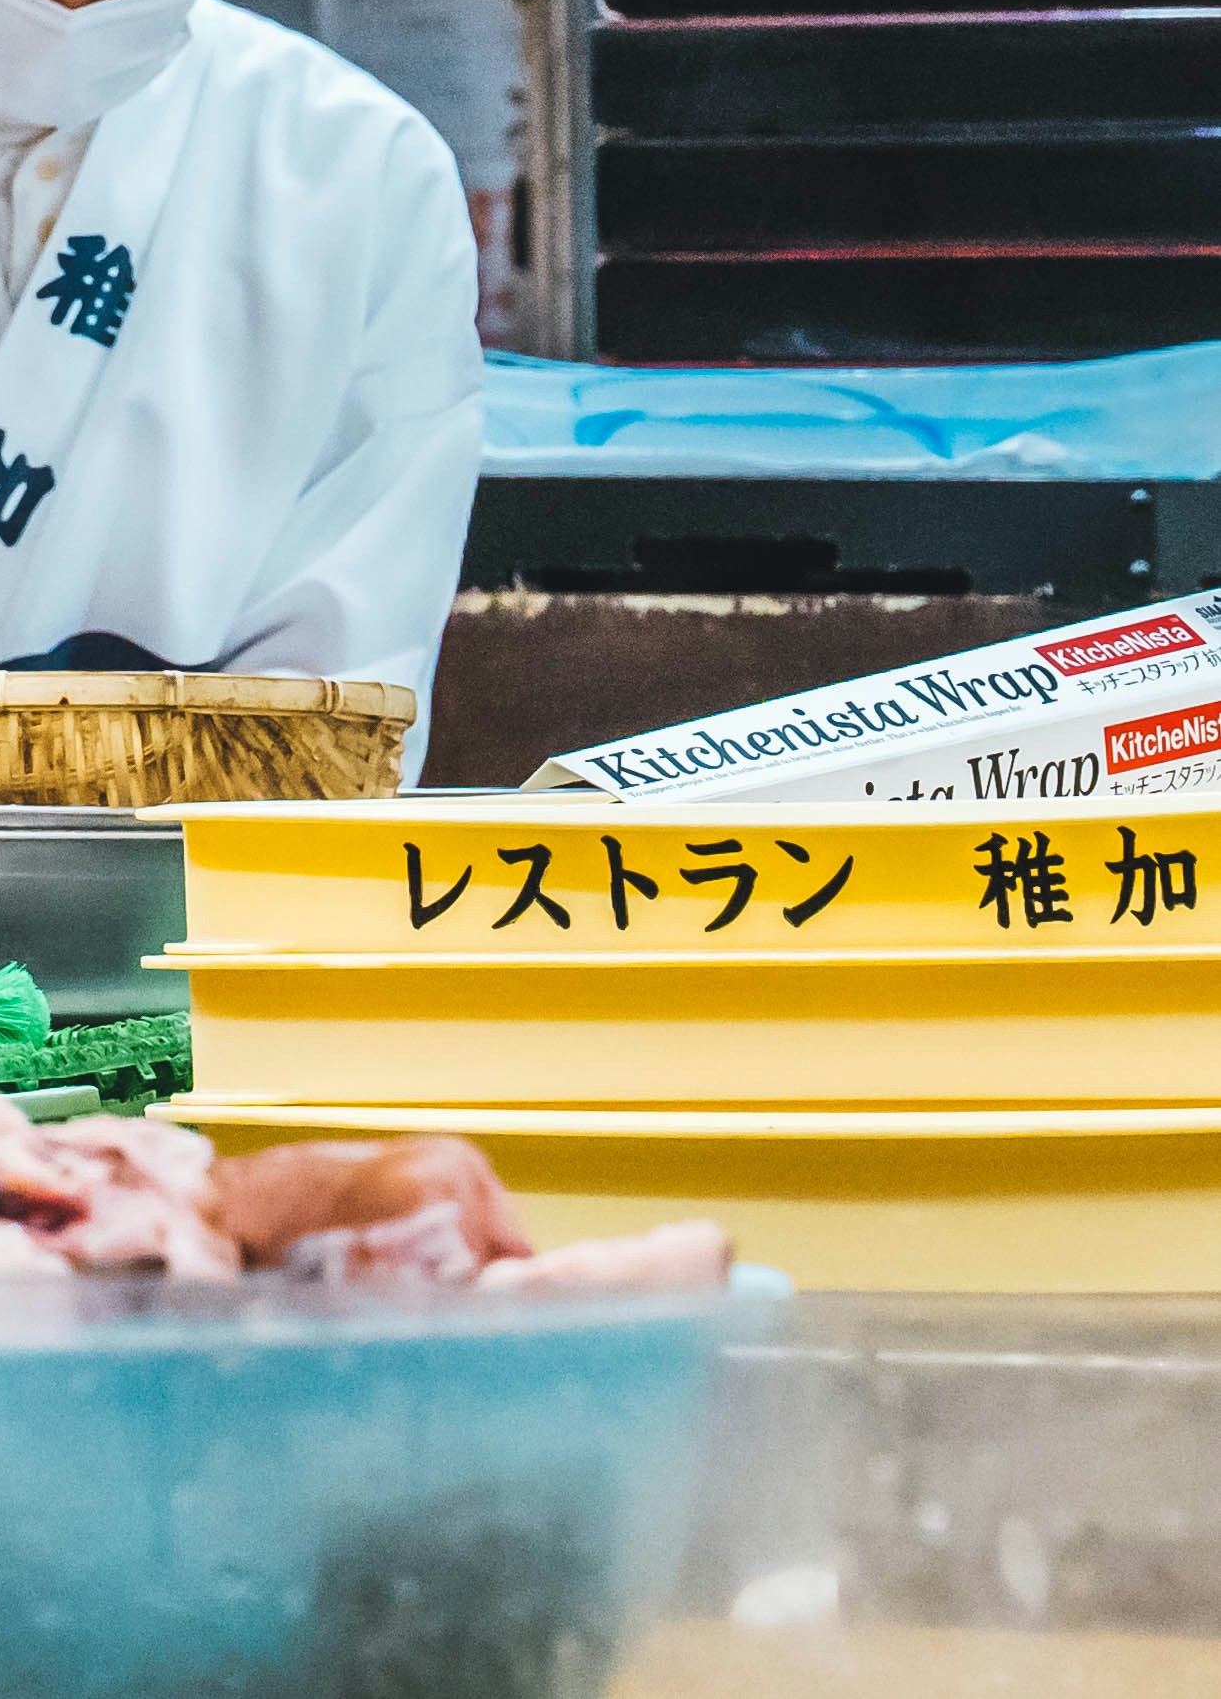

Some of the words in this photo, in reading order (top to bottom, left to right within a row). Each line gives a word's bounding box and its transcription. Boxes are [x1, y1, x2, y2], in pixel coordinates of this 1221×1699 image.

[1047, 625, 1194, 670] KitcheNista
[586, 697, 919, 790] Kitchenista
[896, 662, 1059, 716] Wrap
[1111, 713, 1221, 764] KitcheNis
[404, 836, 853, 932] レストラン
[974, 827, 1196, 928] 稚加
